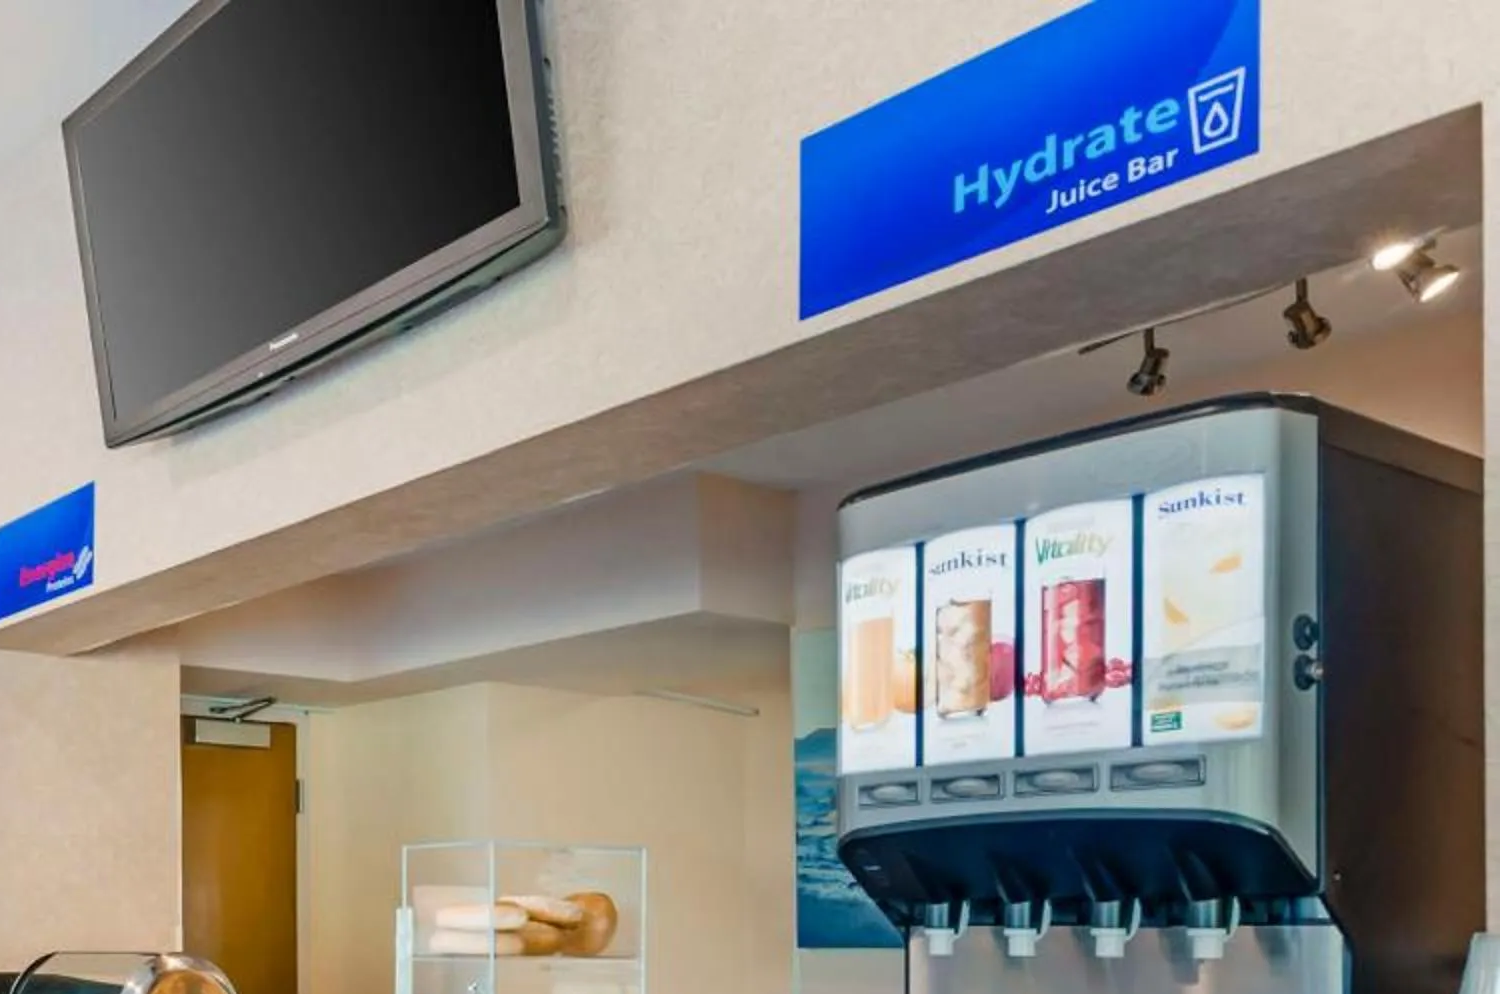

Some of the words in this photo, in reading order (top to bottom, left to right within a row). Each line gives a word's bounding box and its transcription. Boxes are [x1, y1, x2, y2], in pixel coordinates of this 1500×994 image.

[954, 98, 1180, 214] Hydrate
[1046, 171, 1119, 214] Juice
[1127, 148, 1179, 183] Bar
[1035, 532, 1115, 565] Vitality
